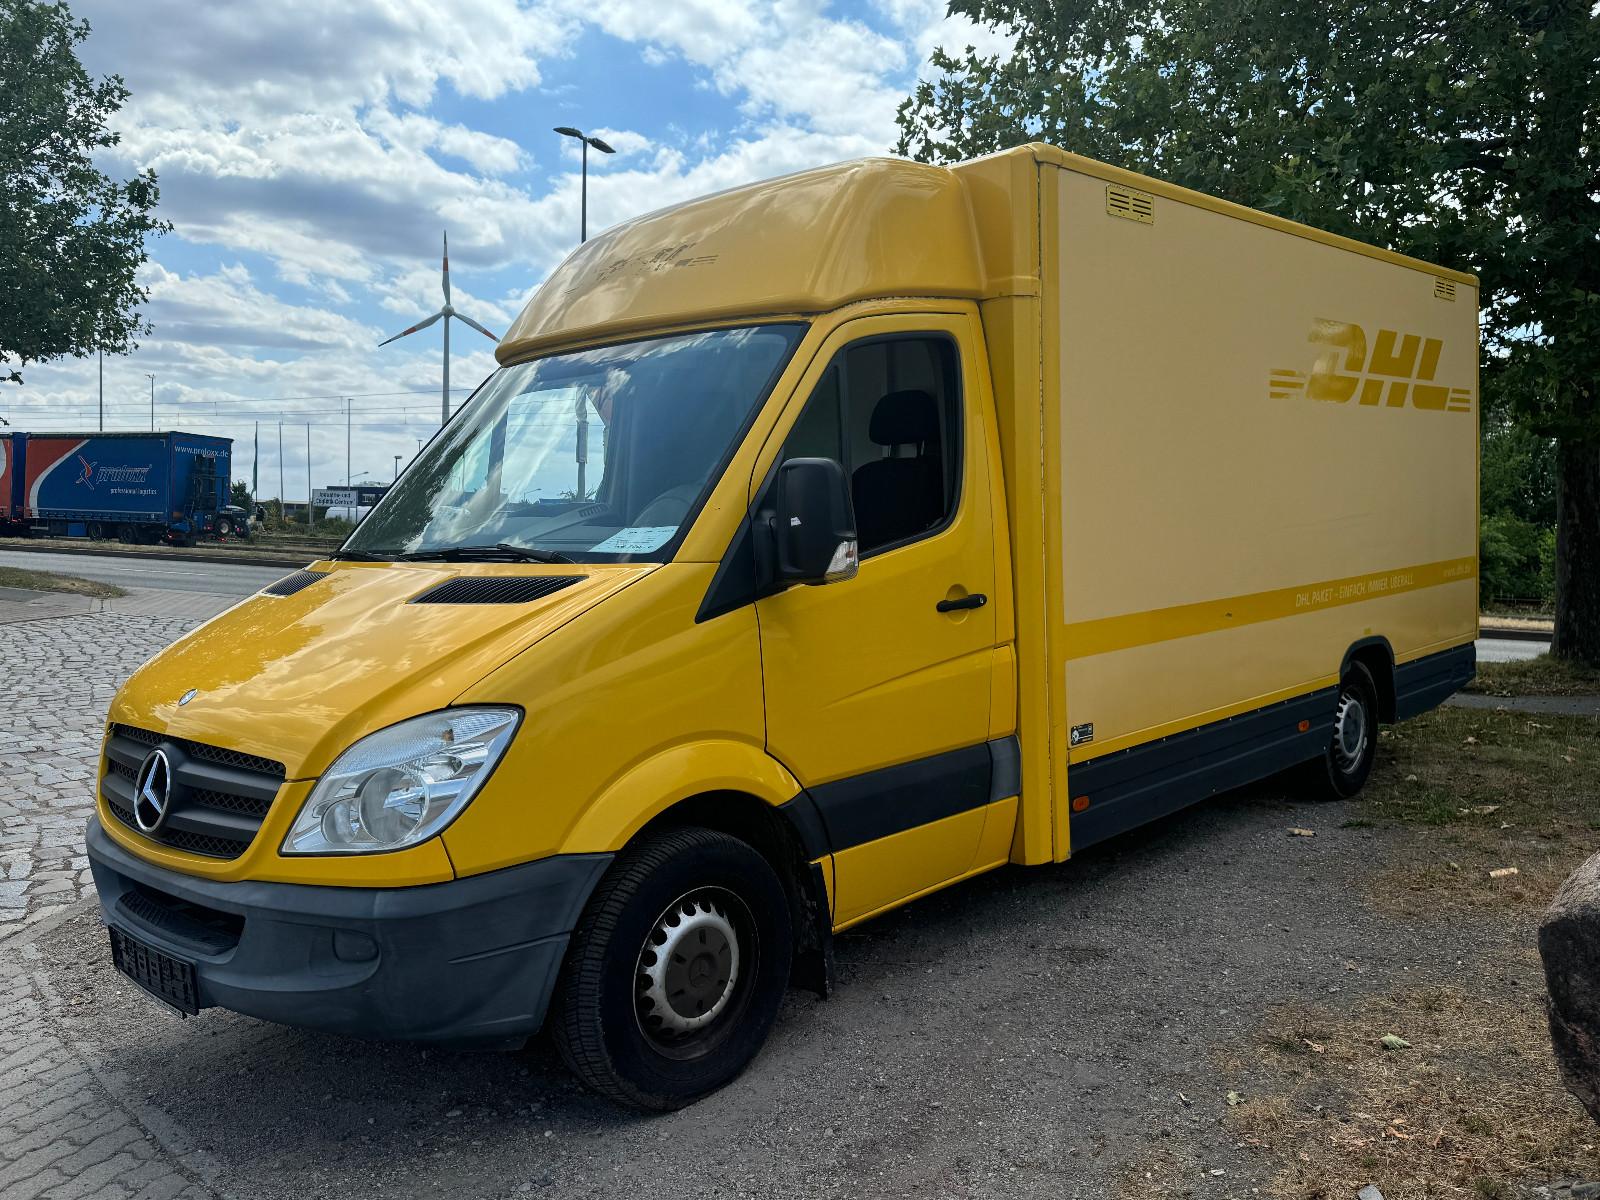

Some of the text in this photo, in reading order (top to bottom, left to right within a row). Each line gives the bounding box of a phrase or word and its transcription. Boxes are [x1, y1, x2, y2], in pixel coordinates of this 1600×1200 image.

[1306, 317, 1449, 411] DHL
[174, 445, 229, 458] www.proloxx.de
[1295, 592, 1310, 607] DHL
[1312, 588, 1333, 605] PAKET
